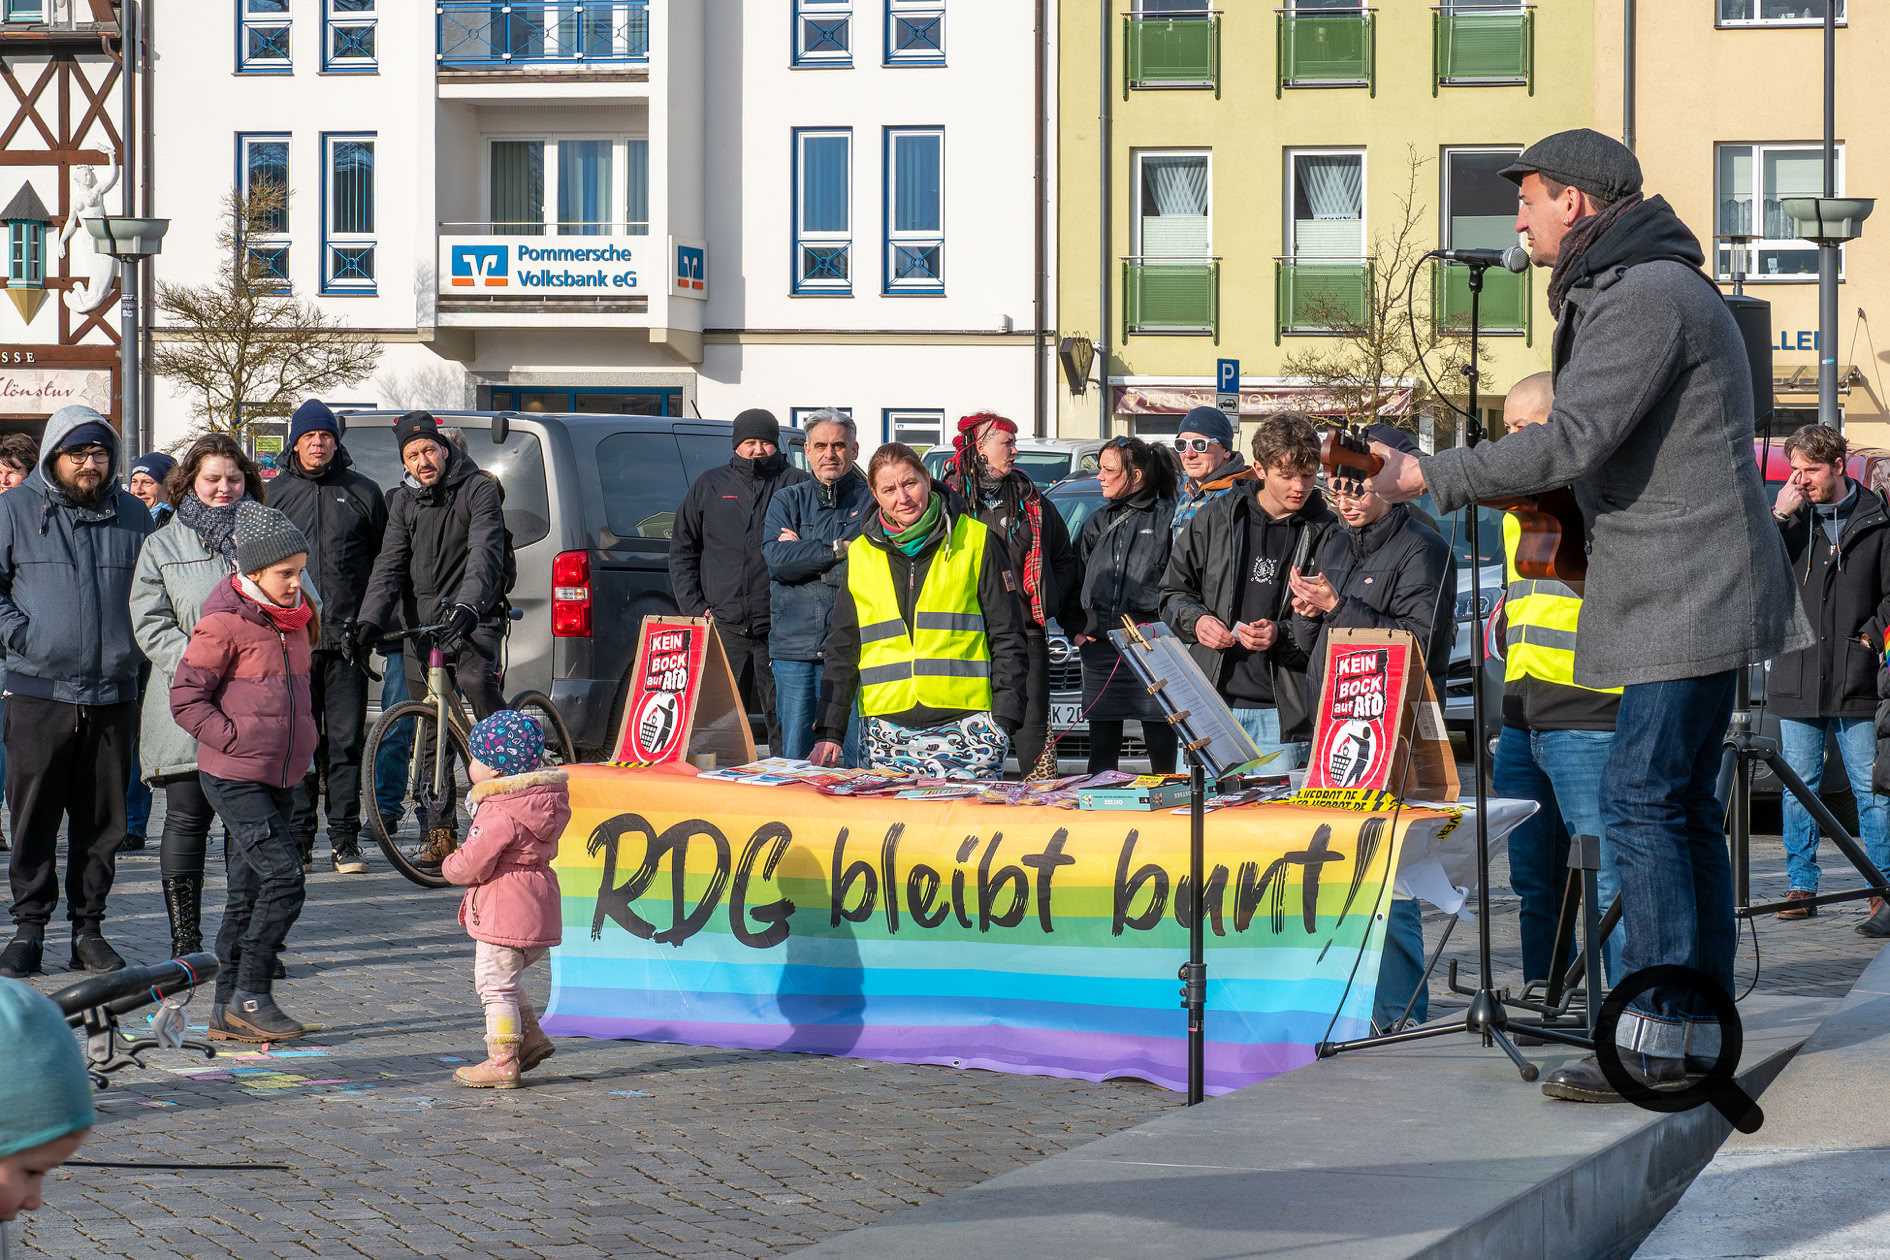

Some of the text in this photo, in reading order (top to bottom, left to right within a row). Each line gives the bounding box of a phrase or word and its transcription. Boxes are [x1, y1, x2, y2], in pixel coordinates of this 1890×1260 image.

[517, 244, 632, 262] Pommersche
[517, 270, 638, 288] Volksbank eG
[1221, 363, 1235, 389] P
[0, 376, 75, 398] lönstuv
[652, 633, 683, 652] KEIN
[651, 653, 687, 673] BOCK
[1338, 654, 1377, 676] KEIN
[646, 675, 662, 686] auf
[1339, 675, 1383, 699] BOCK
[1334, 700, 1353, 714] auf
[586, 813, 796, 949] RDG
[830, 822, 1075, 935] bleibt
